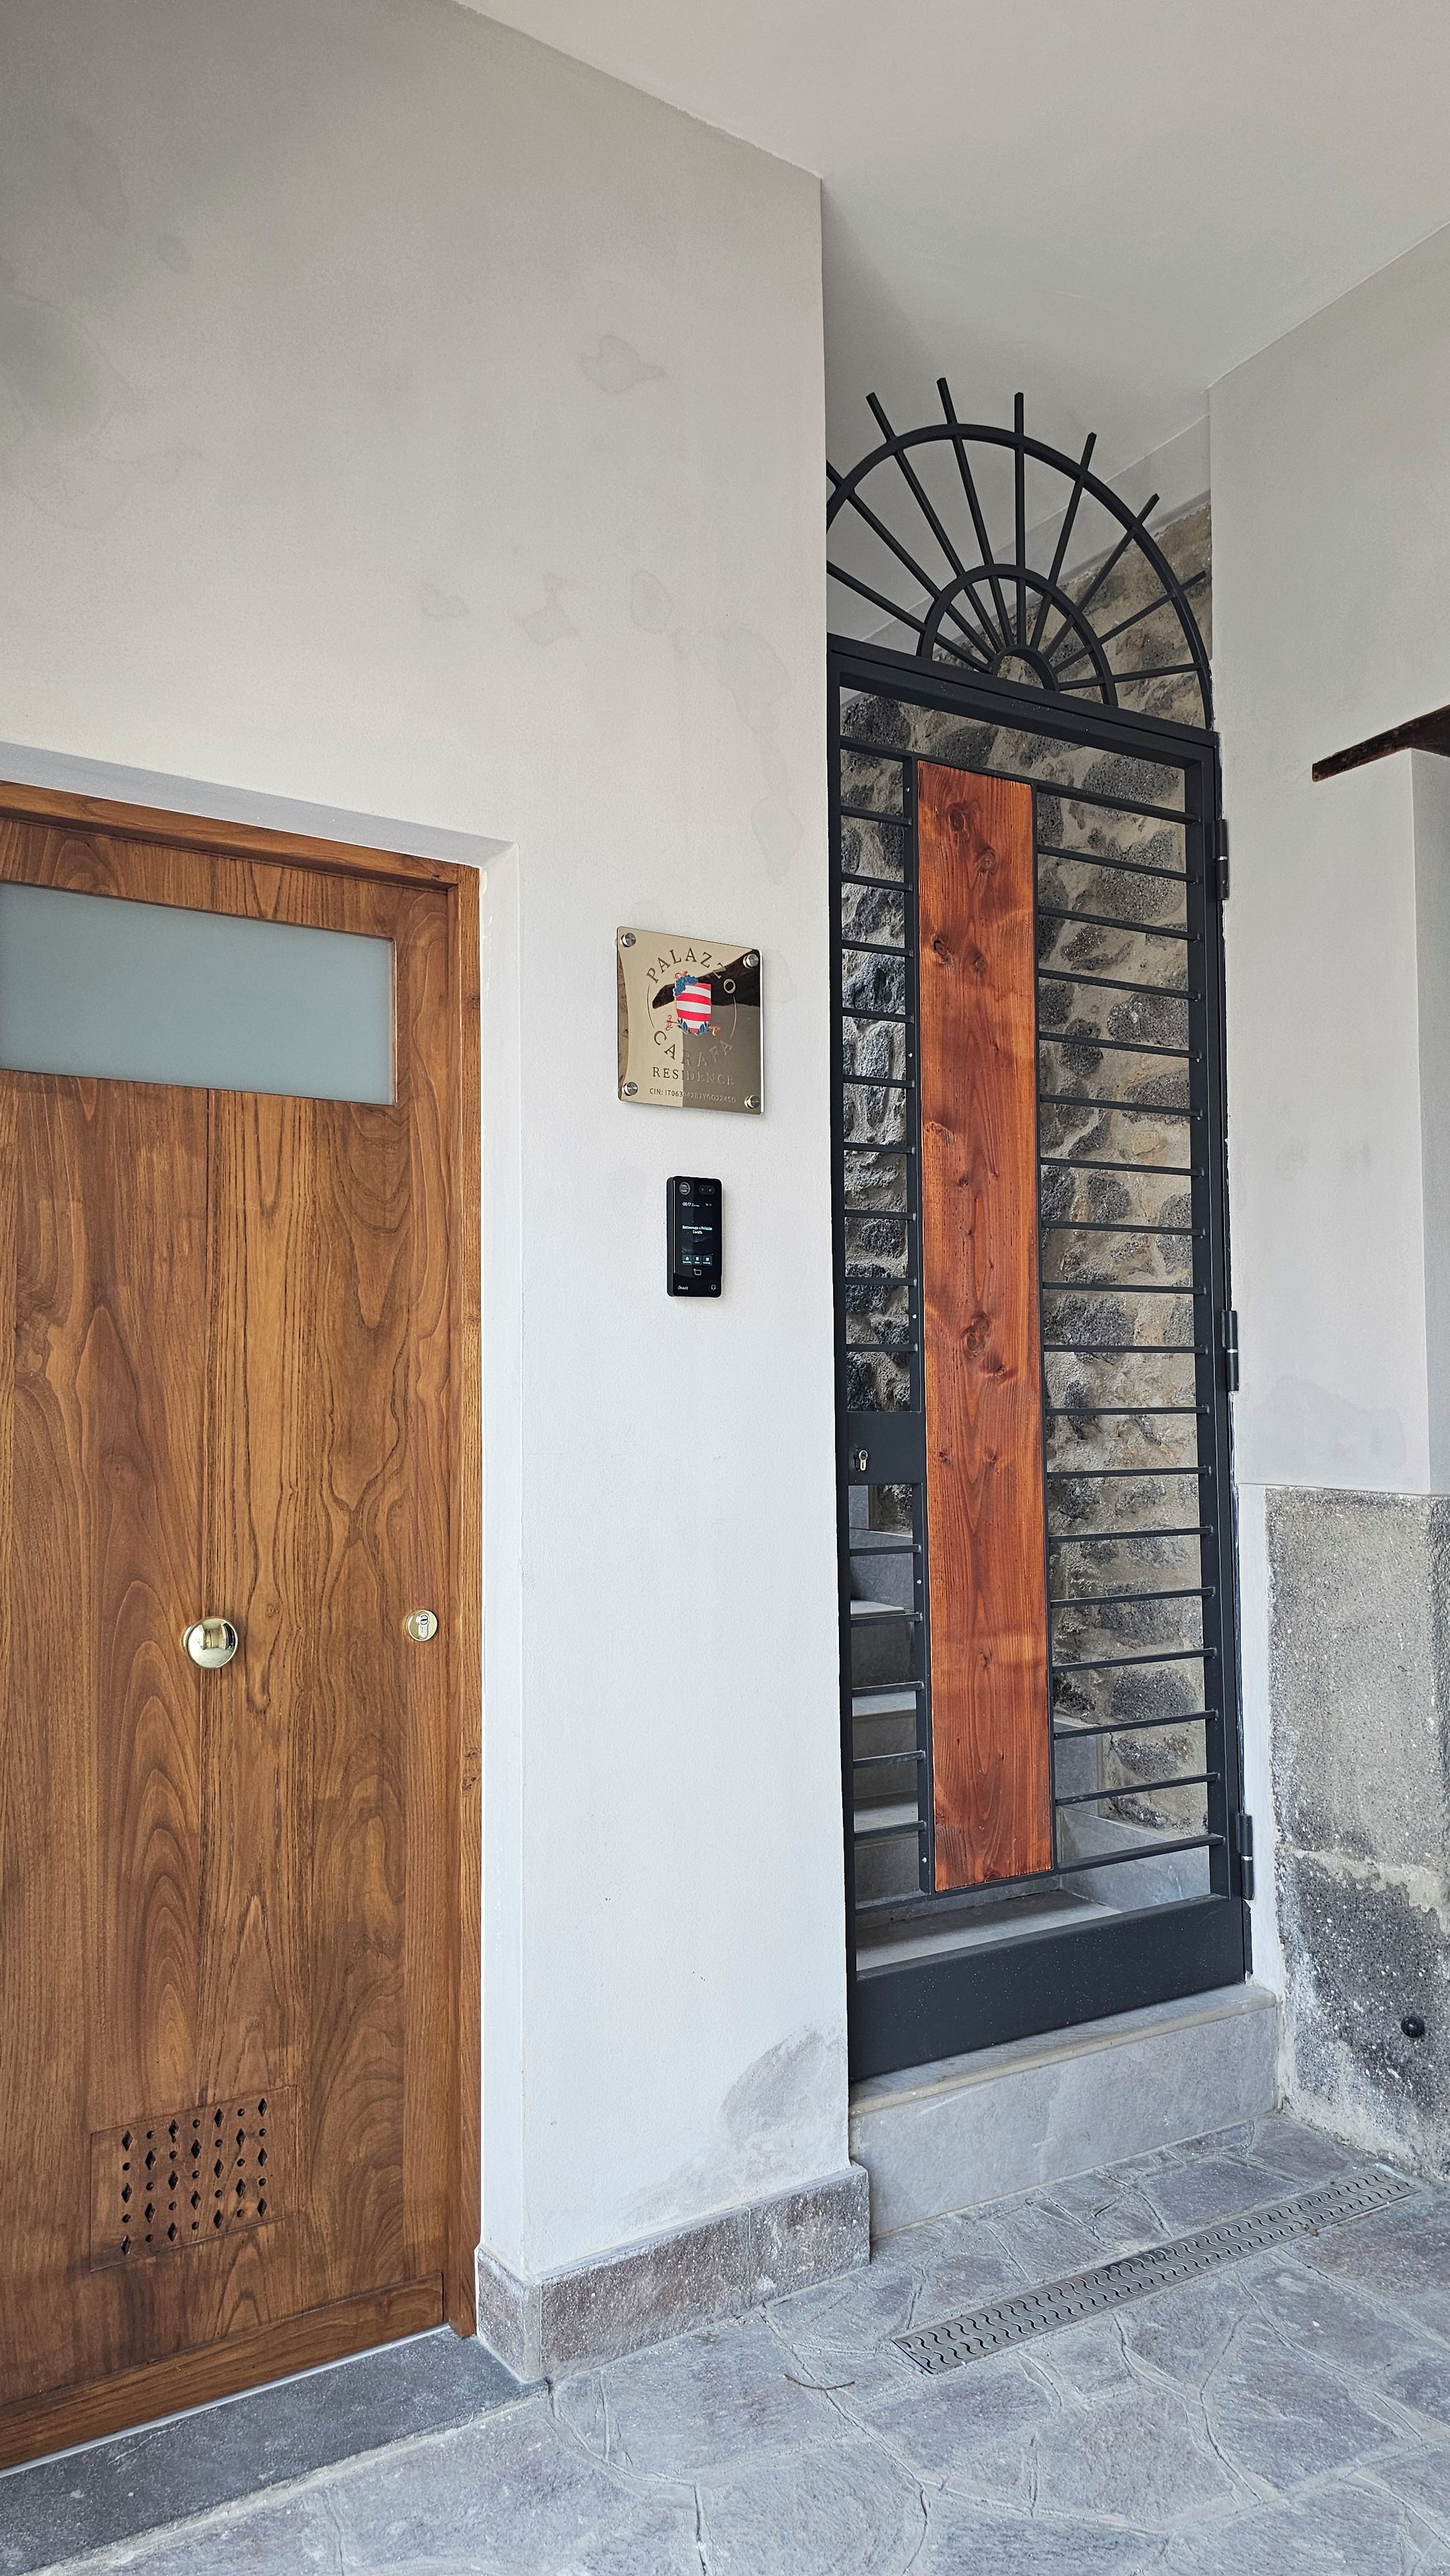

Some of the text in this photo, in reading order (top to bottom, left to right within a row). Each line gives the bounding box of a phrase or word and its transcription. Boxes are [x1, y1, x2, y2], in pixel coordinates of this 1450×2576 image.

[646, 947, 736, 994] PALAZZO
[654, 1030, 732, 1067] CARAFA
[653, 1066, 734, 1085] RESIDENCE
[649, 1087, 663, 1095] CIN:
